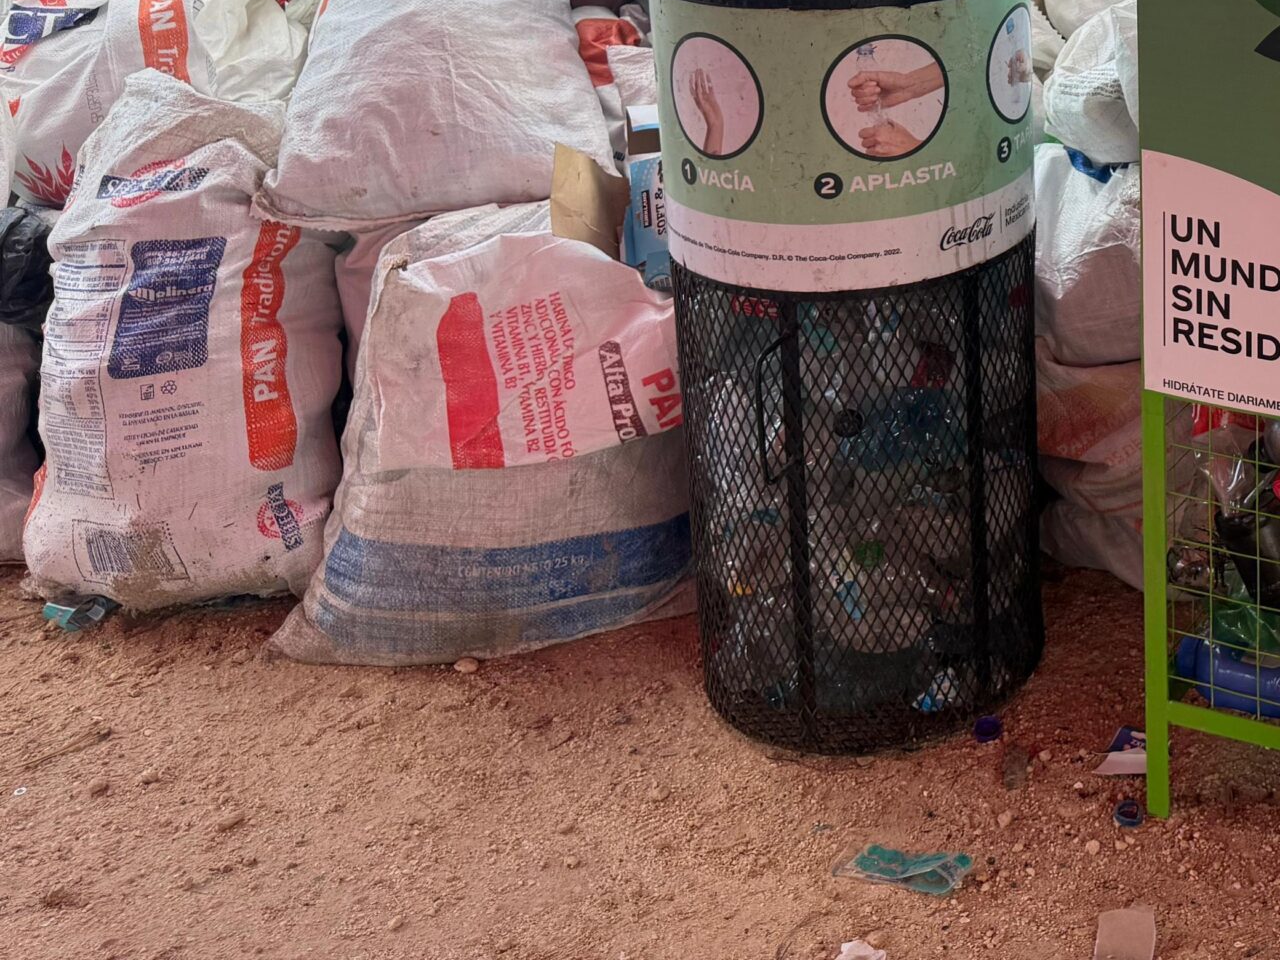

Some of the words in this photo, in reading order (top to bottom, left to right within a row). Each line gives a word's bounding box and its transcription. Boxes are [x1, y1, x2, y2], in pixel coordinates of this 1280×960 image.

[697, 167, 755, 192] VACÍA
[820, 178, 836, 194] 2
[850, 162, 957, 193] APLASTA
[1171, 214, 1220, 248] UN
[809, 254, 846, 262] Coca-Cola
[847, 251, 882, 261] Company.
[1171, 284, 1231, 320] SIN
[490, 319, 513, 376] VITAMINA
[548, 291, 574, 337] HARINA
[562, 353, 576, 390] TRIGO
[252, 338, 279, 402] PAN
[506, 306, 527, 361] VITAMINA
[526, 439, 541, 454] B2
[547, 369, 562, 399] CON
[1163, 378, 1224, 401] HIDRÁTATE
[554, 557, 569, 571] 25
